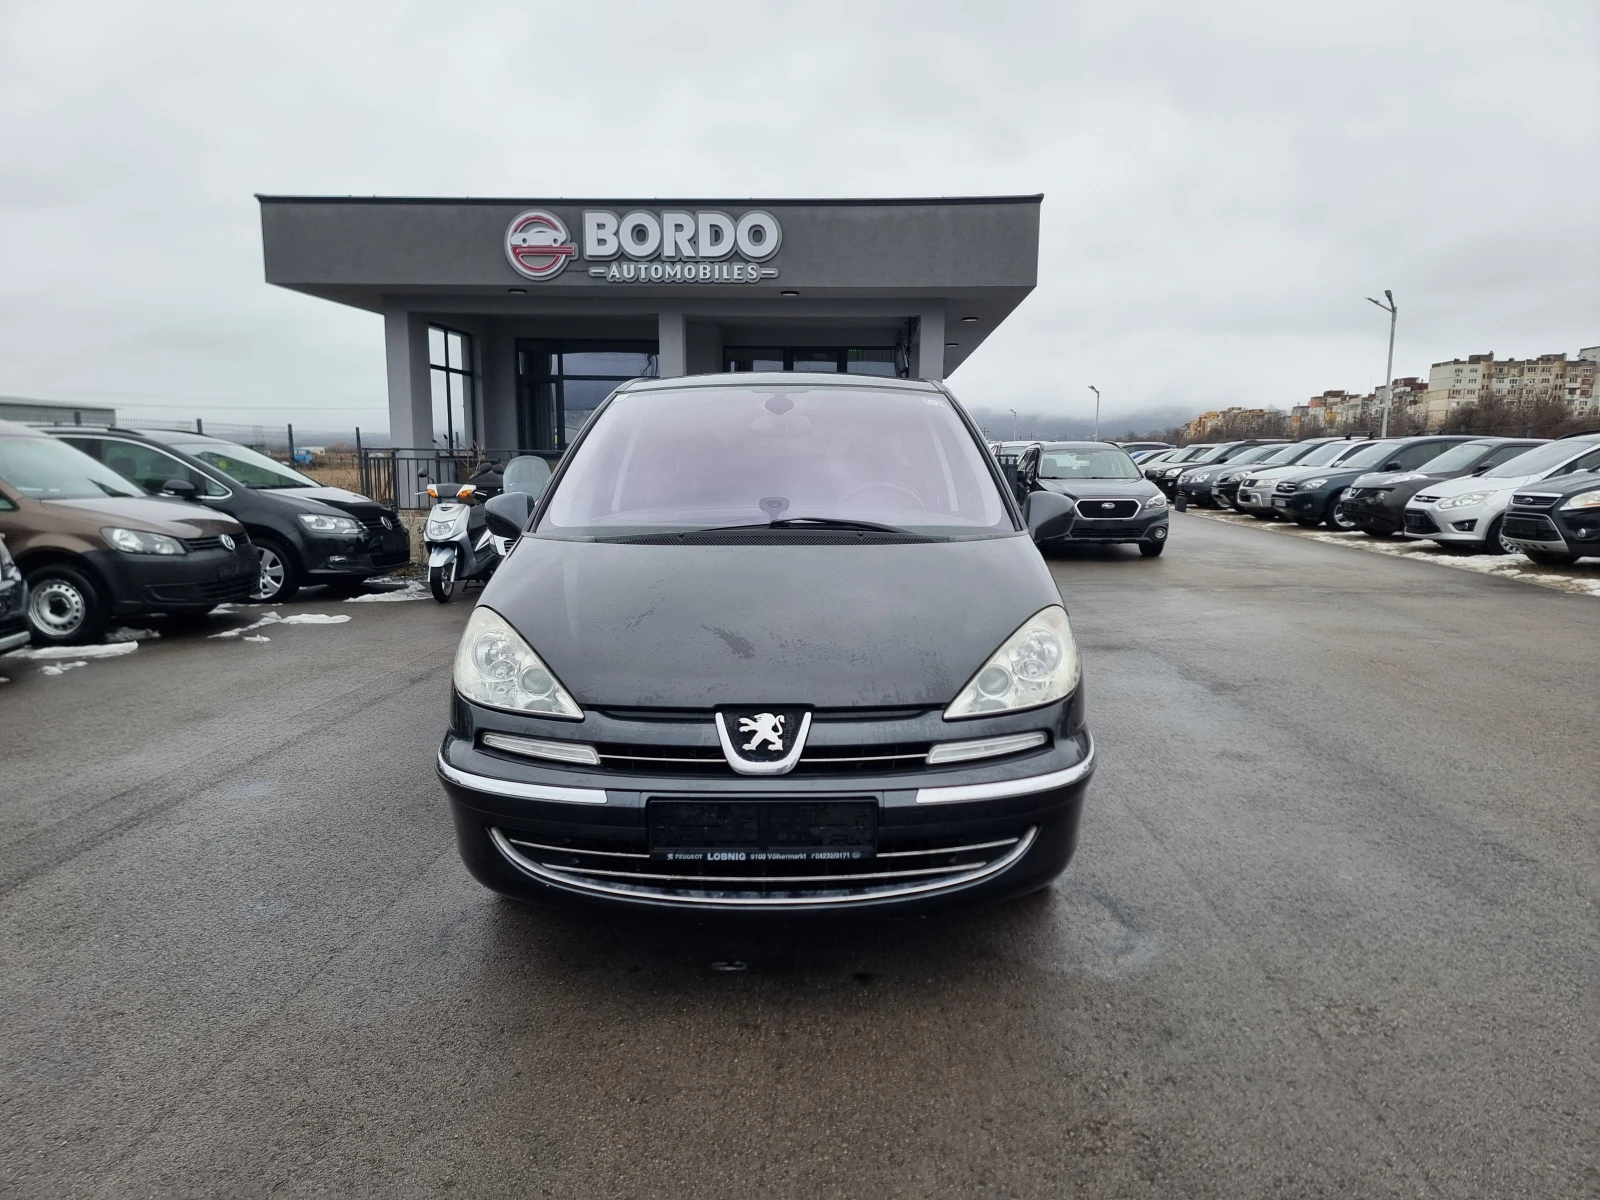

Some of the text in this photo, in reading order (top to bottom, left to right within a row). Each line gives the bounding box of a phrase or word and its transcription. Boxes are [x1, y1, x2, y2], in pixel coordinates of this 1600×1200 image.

[584, 211, 779, 258] BORDO
[608, 264, 758, 280] AUTOMOBILES
[767, 852, 807, 860] Völkermarkt
